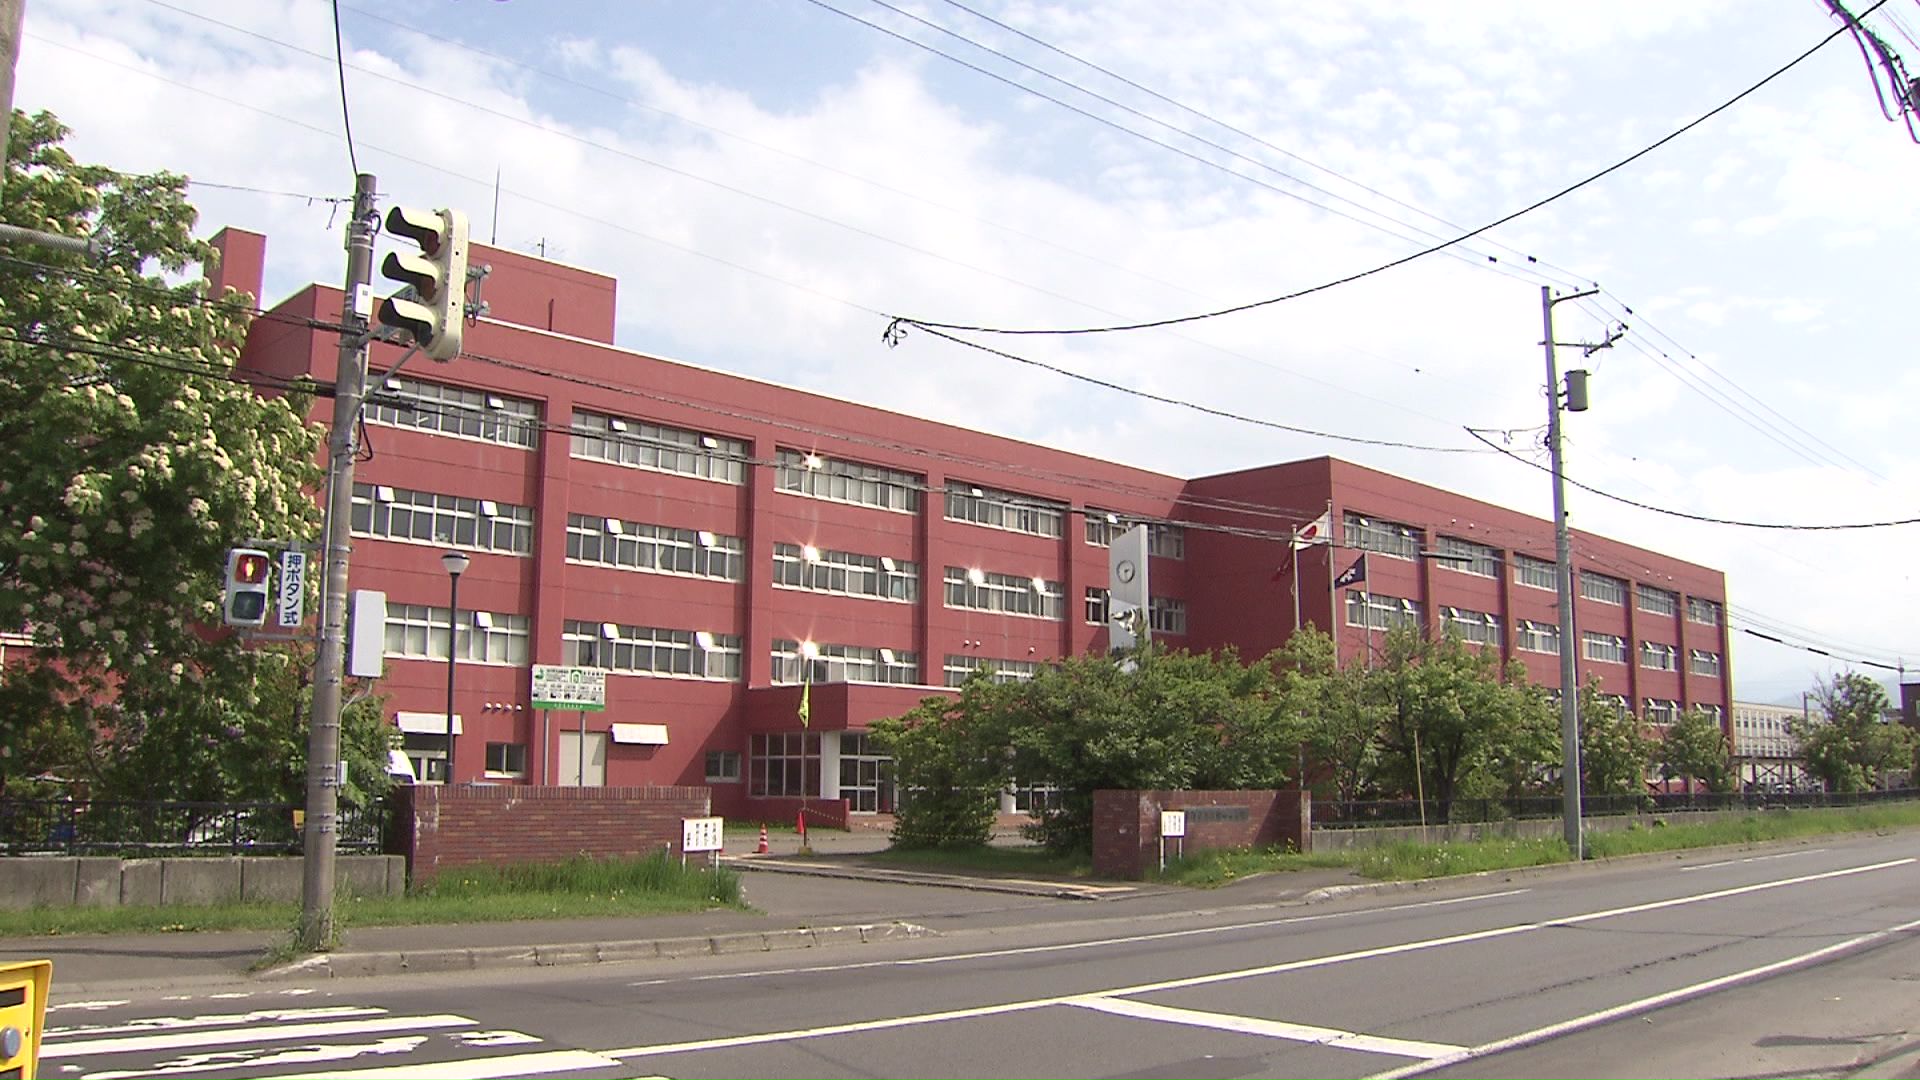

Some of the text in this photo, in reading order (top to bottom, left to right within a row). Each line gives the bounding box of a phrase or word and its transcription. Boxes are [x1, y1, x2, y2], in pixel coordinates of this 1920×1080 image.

[284, 554, 302, 625] 押ボタン式
